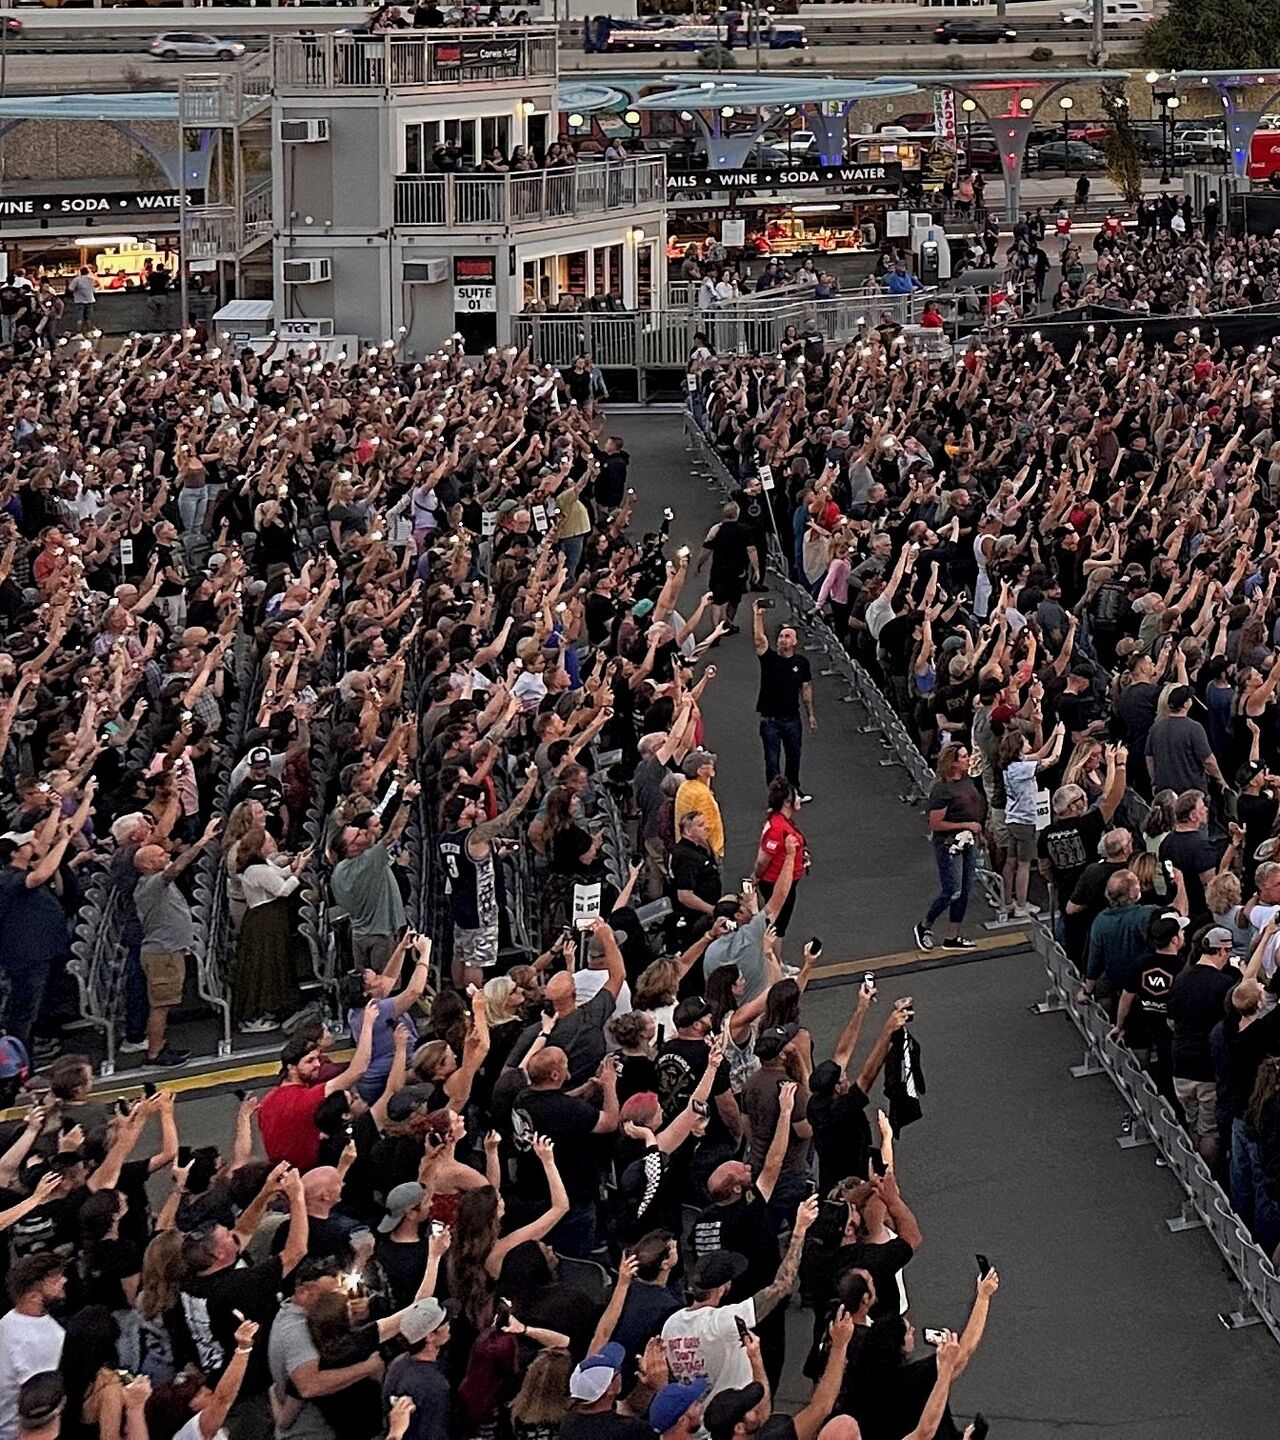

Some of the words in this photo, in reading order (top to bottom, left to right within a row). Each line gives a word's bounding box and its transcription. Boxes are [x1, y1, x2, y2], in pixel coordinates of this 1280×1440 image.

[719, 173, 758, 185] WINE
[779, 171, 819, 183] SODA
[840, 167, 886, 180] WATER
[61, 198, 110, 212] SODA
[137, 195, 192, 209] WATER
[458, 287, 492, 299] SUITE
[468, 299, 481, 310] 01
